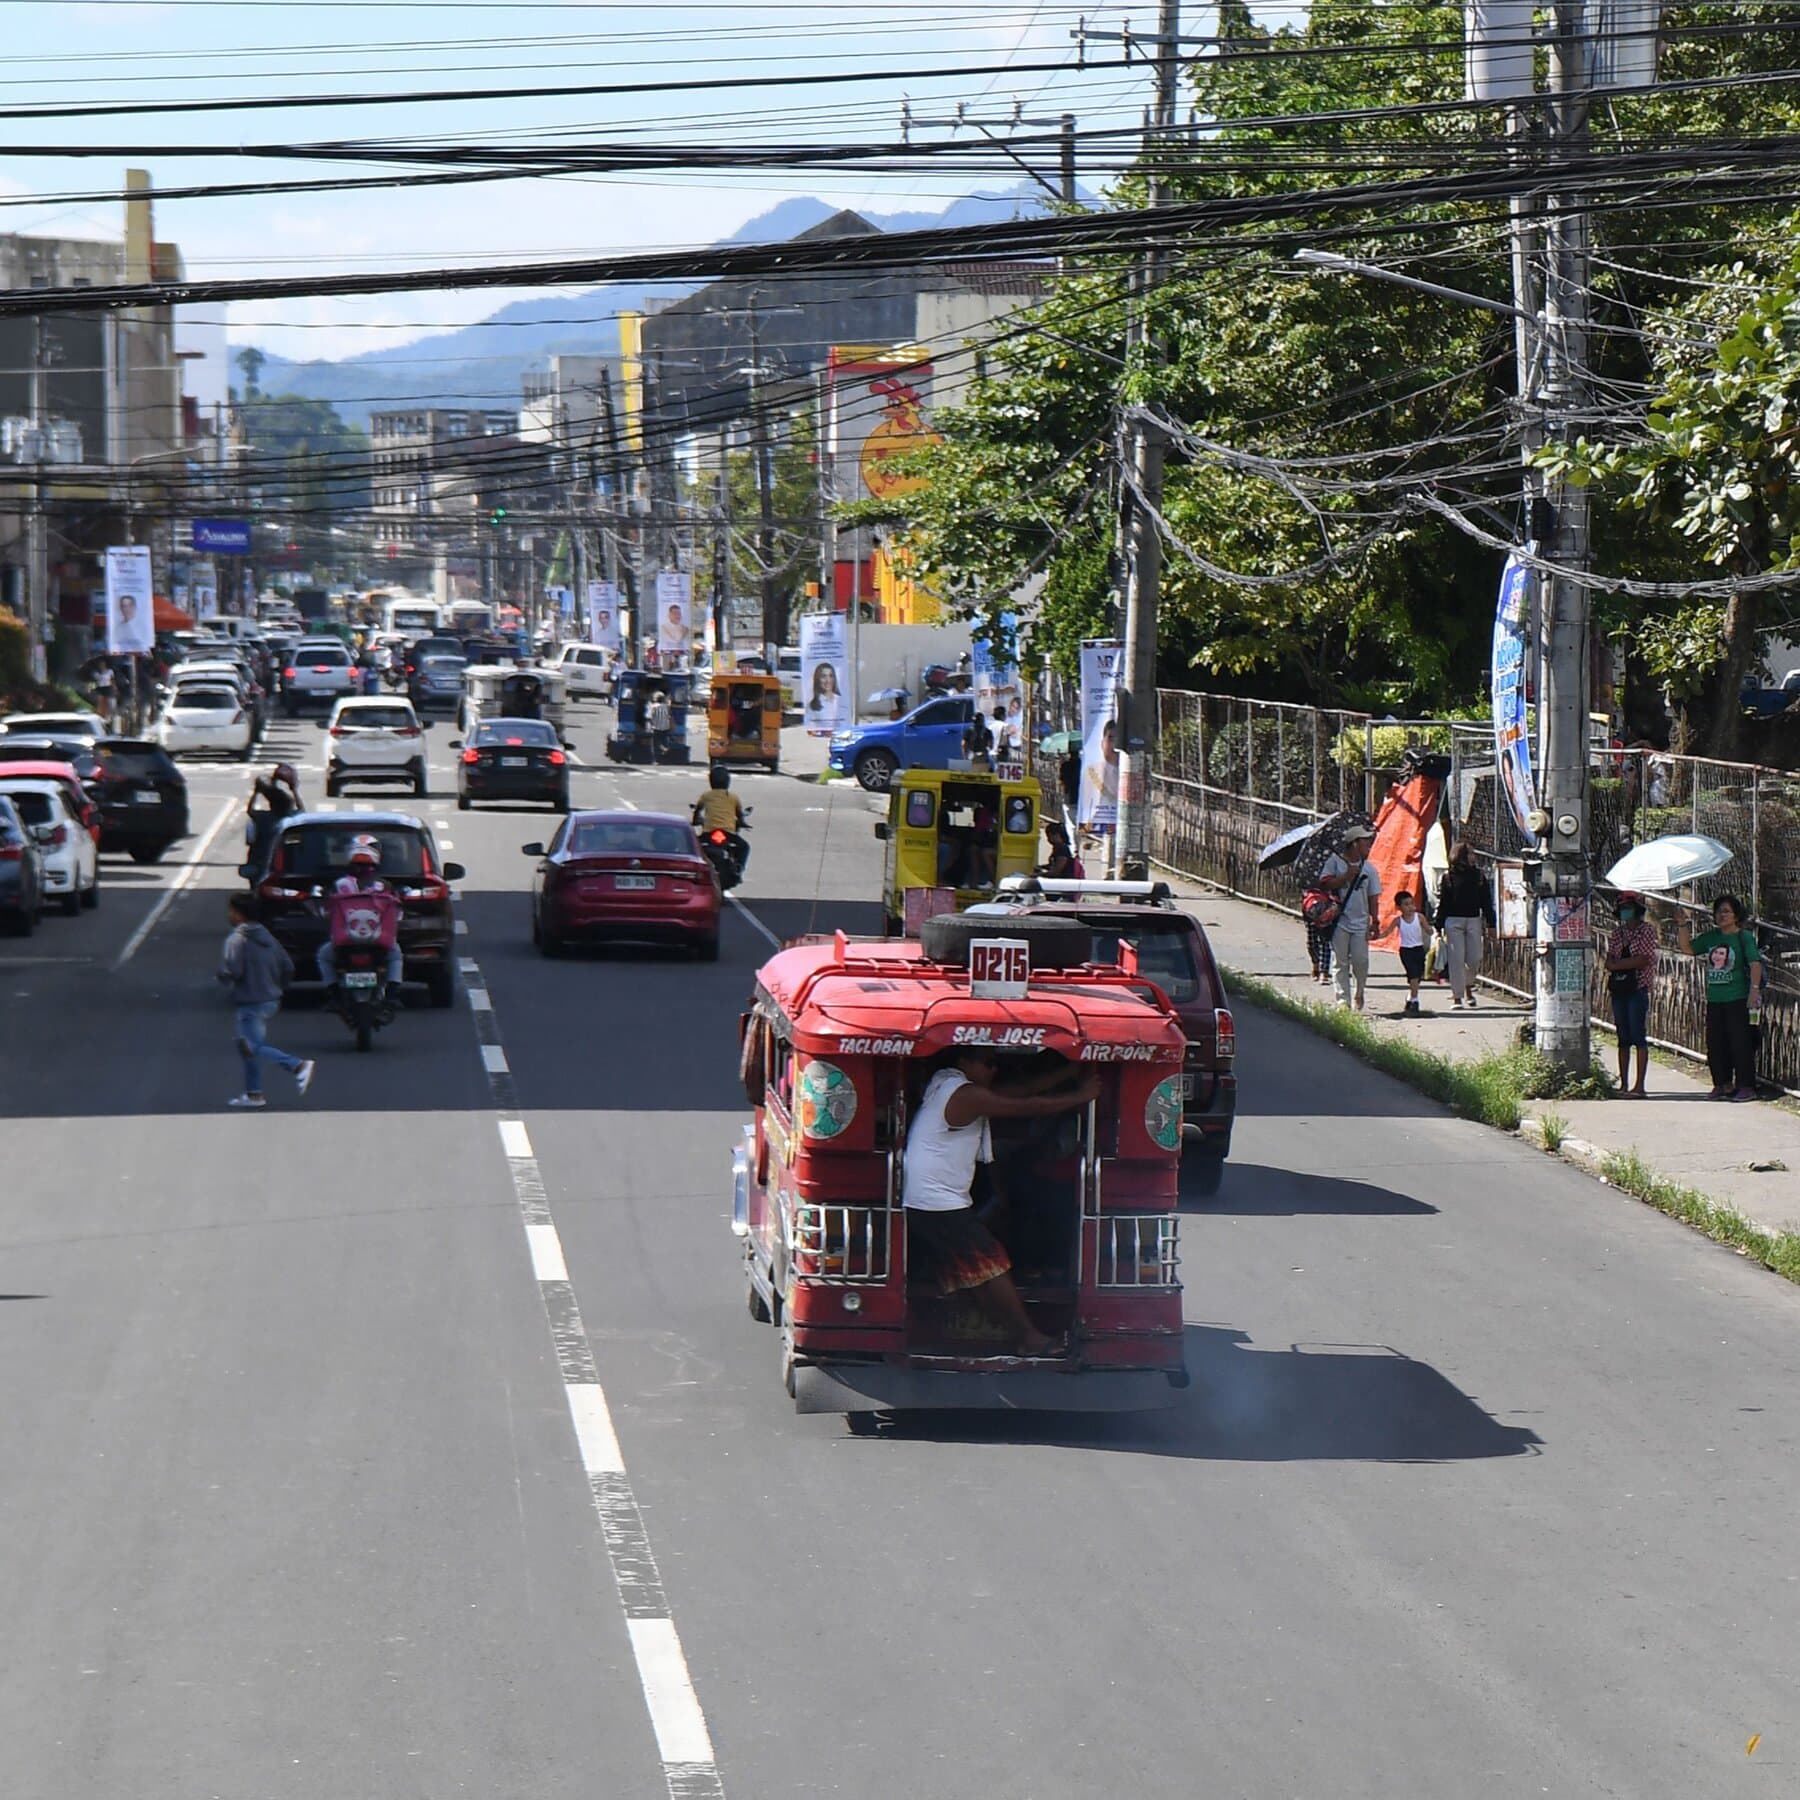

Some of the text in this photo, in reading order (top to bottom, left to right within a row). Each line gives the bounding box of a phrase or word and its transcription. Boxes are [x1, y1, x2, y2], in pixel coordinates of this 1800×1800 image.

[972, 946, 1027, 982] 0215
[953, 1026, 1046, 1044] SAN JOSE
[839, 1038, 914, 1055] TACLOBAN
[1080, 1043, 1157, 1061] AIRPORT
